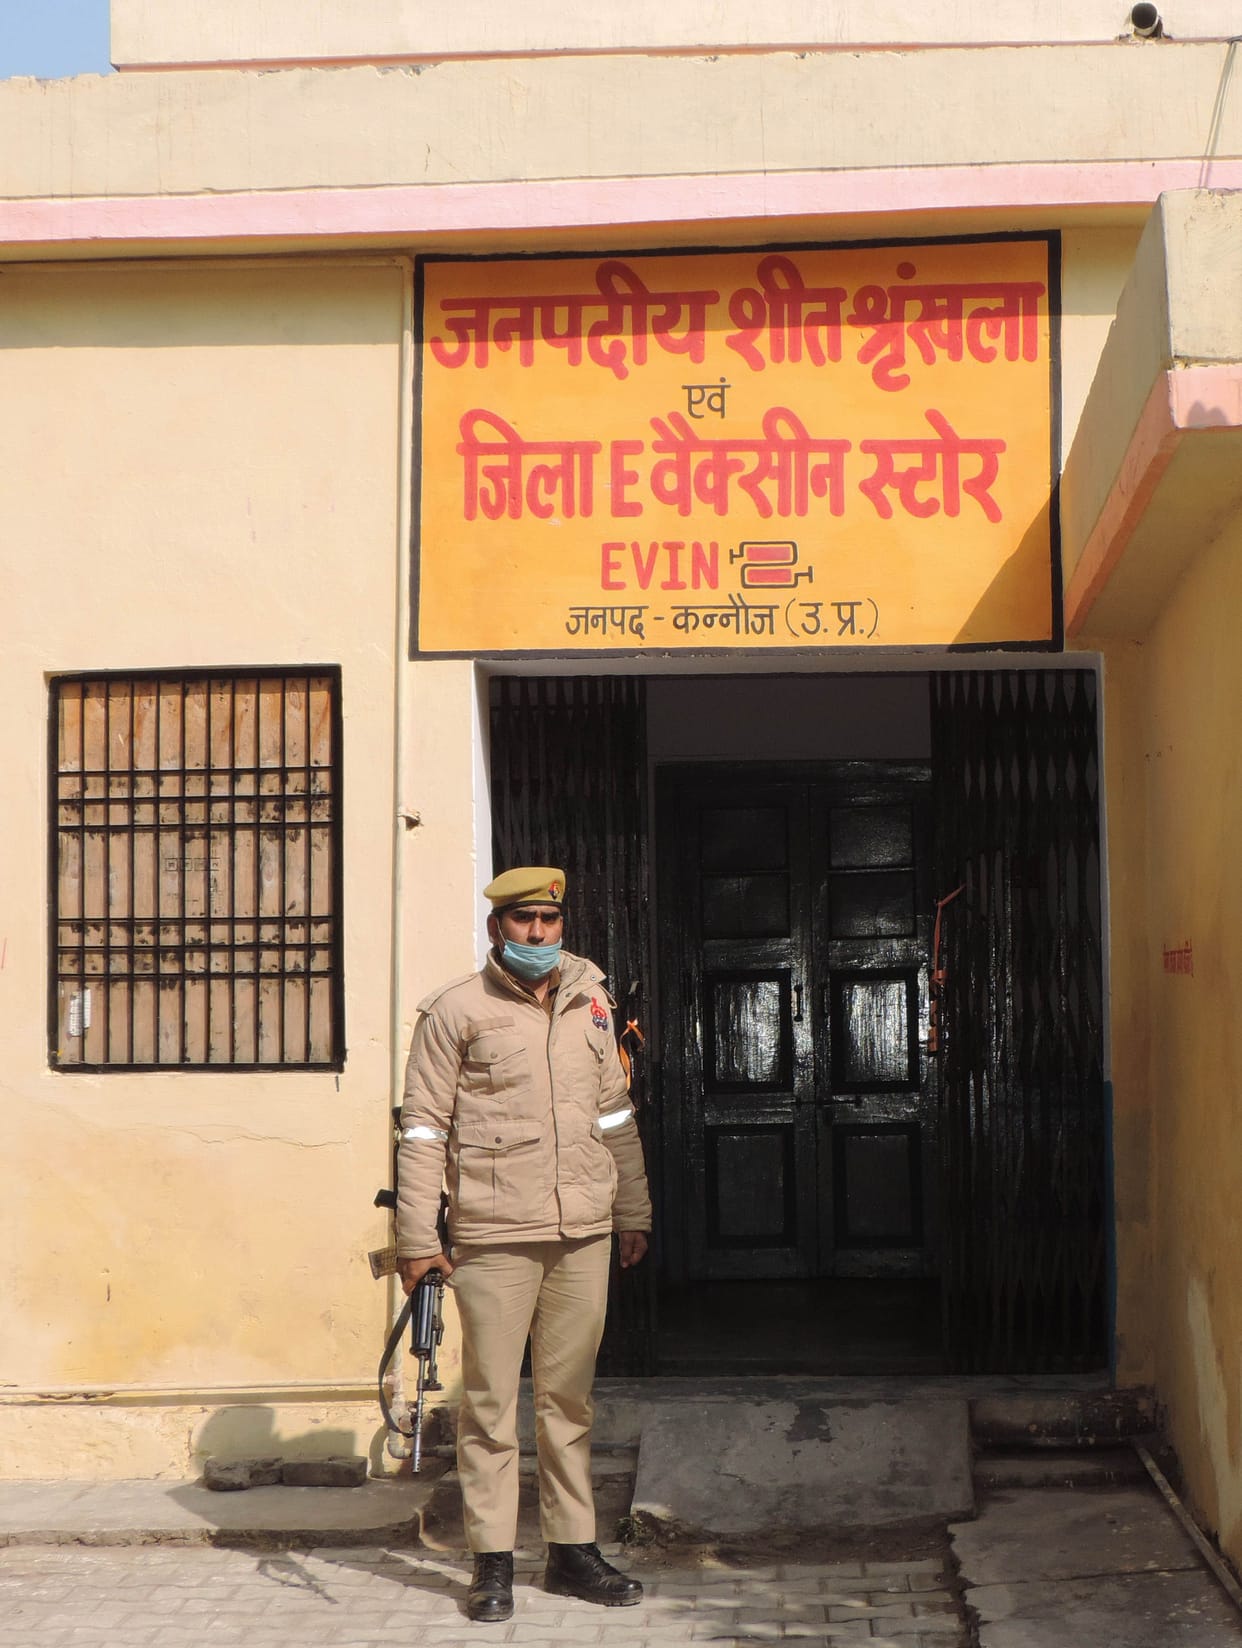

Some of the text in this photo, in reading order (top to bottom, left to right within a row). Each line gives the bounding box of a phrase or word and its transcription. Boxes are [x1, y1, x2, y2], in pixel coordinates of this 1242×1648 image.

[430, 260, 720, 380] जनपदीय
[726, 255, 848, 371] शीत
[681, 376, 731, 419] एवं
[456, 406, 1007, 523] जिला E वैक्सीन स्टोर
[600, 541, 719, 590] EVIN
[565, 605, 649, 639] जनपद
[670, 593, 780, 635] कन्नौज
